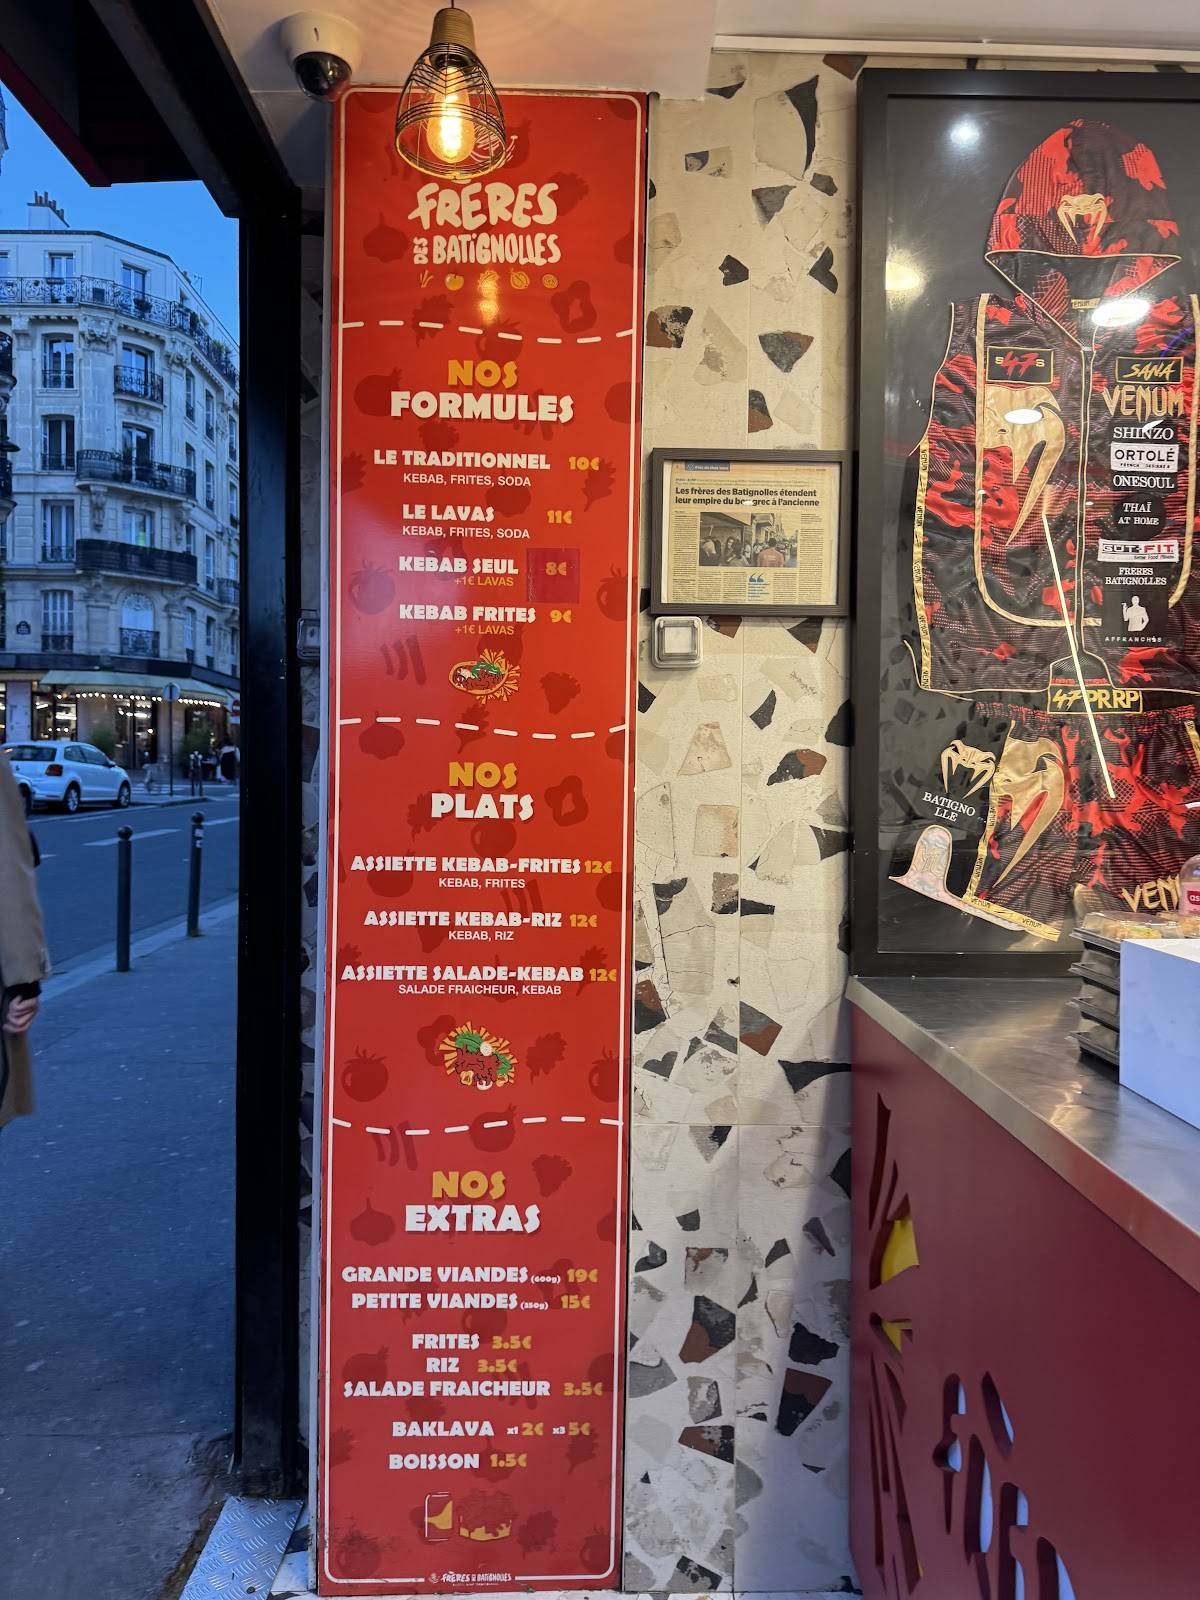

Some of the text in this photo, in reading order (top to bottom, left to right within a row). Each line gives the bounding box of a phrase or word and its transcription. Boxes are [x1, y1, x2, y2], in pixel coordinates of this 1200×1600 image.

[413, 236, 429, 265] DES
[447, 359, 518, 388] NOS
[390, 390, 575, 423] FORMULES
[1101, 384, 1185, 423] VENUM
[1113, 426, 1174, 440] SHINZO
[373, 449, 600, 471] LE TRADITIONNEL 10€
[1114, 448, 1175, 462] ORTOLÉ
[403, 472, 531, 487] KEBAB, FRITES, SODA
[1113, 475, 1175, 489] ONESOUL
[675, 487, 817, 497] Les frères des Batignolles étendent
[675, 496, 691, 504] leur
[692, 496, 722, 506] empire
[722, 497, 734, 505] du
[752, 498, 771, 507] grec
[771, 498, 777, 506] à
[778, 498, 820, 507] l'ancienne
[1123, 501, 1152, 513] THAÏ
[402, 504, 572, 525] LE LAVAS 11€
[1118, 517, 1160, 525] AT HOME
[402, 525, 530, 539] KEBAB, FRITES, SODA
[399, 556, 567, 576] KEBAB SEUL 8€
[454, 575, 514, 587] +1€ LAVAS
[1105, 577, 1167, 585] BATIGNOLLES
[399, 604, 572, 624] KEBAB FRITES 9€
[455, 624, 514, 636] +1€ LAVAS
[448, 761, 518, 789] NOS
[431, 792, 534, 822] PLATS
[922, 791, 976, 817] BATIGNO
[934, 807, 959, 822] LLE
[351, 855, 612, 874] ASSIETTE KEBAB-FRITES 12€
[439, 877, 526, 889] KEBAB, FRITES
[364, 910, 598, 928] ASSIETTE KEBAB-RIZ 12€
[448, 930, 514, 942] KEBAB, RIZ
[341, 964, 617, 982] ASSIETTE SALADE-KEBAB 12€
[398, 984, 562, 996] SALADE FRAICHEUR, KEBAB
[432, 1170, 506, 1200] NOS
[405, 1204, 541, 1234] EXTRAS
[341, 1265, 599, 1285] GRANDE VIANDES (600g) 19€
[351, 1293, 422, 1309] PETITE
[426, 1293, 518, 1310] VIANDES
[560, 1295, 591, 1309] 15€
[411, 1333, 532, 1350] FRITES 3.5€
[426, 1357, 517, 1373] RIZ 3.5€
[343, 1380, 603, 1397] SALADE FRAICHEUR 3.5€
[392, 1420, 495, 1437] BAKLAVA
[506, 1426, 519, 1435] x1
[521, 1422, 544, 1436] 2€
[568, 1422, 590, 1436] 5€
[389, 1453, 527, 1470] BOISSON 1.5€
